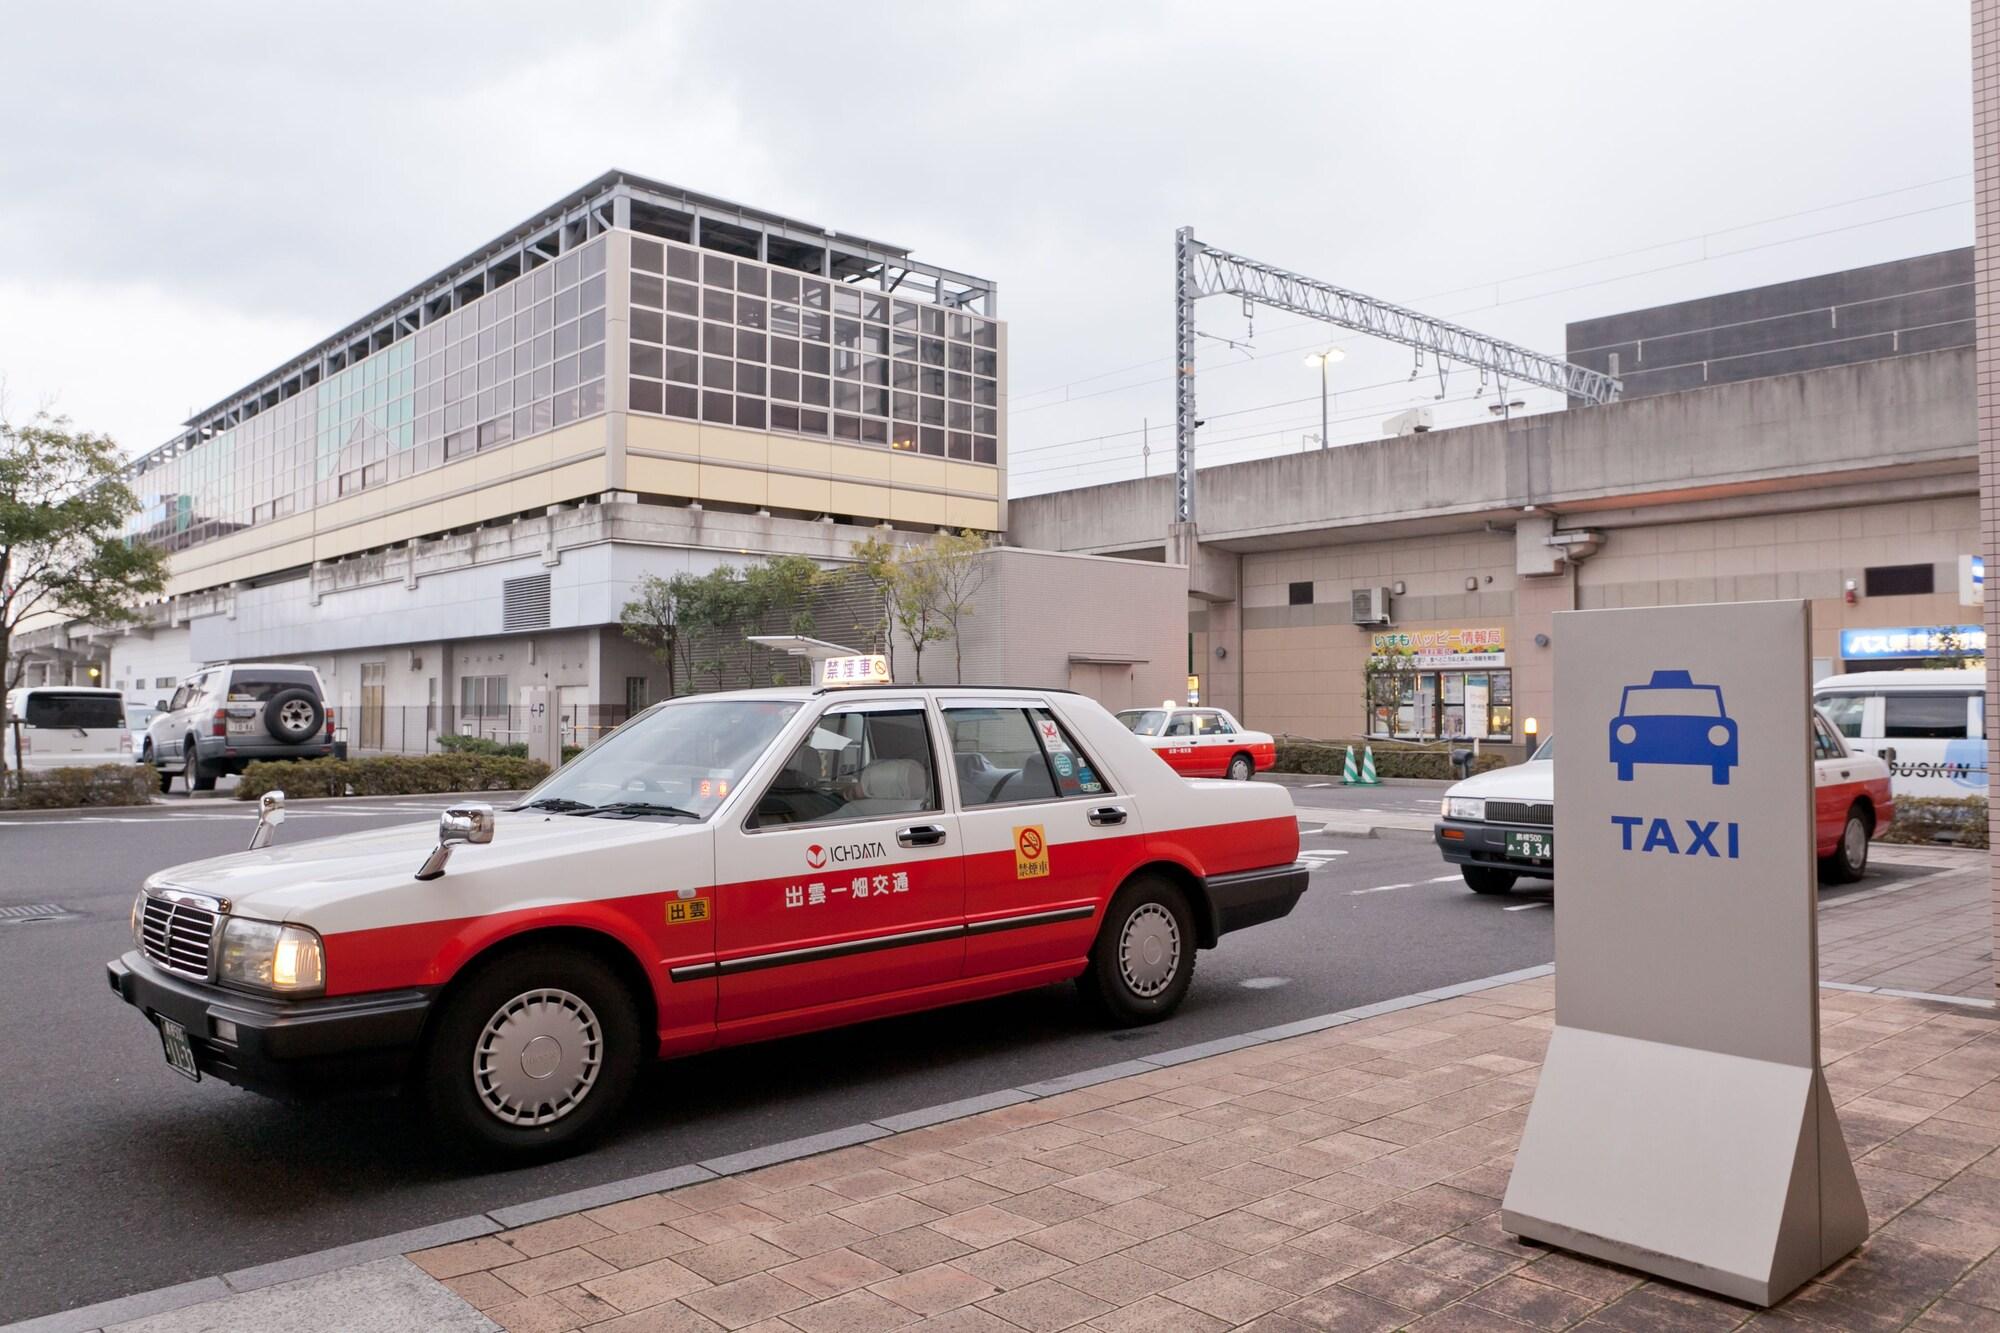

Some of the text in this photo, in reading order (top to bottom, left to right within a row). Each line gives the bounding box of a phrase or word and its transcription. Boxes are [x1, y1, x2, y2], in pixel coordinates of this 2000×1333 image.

[826, 658, 872, 679] 禁煙車
[1611, 815, 1739, 859] TAXI
[784, 871, 910, 908] 出雲一畑交通
[670, 900, 706, 921] 出雲
